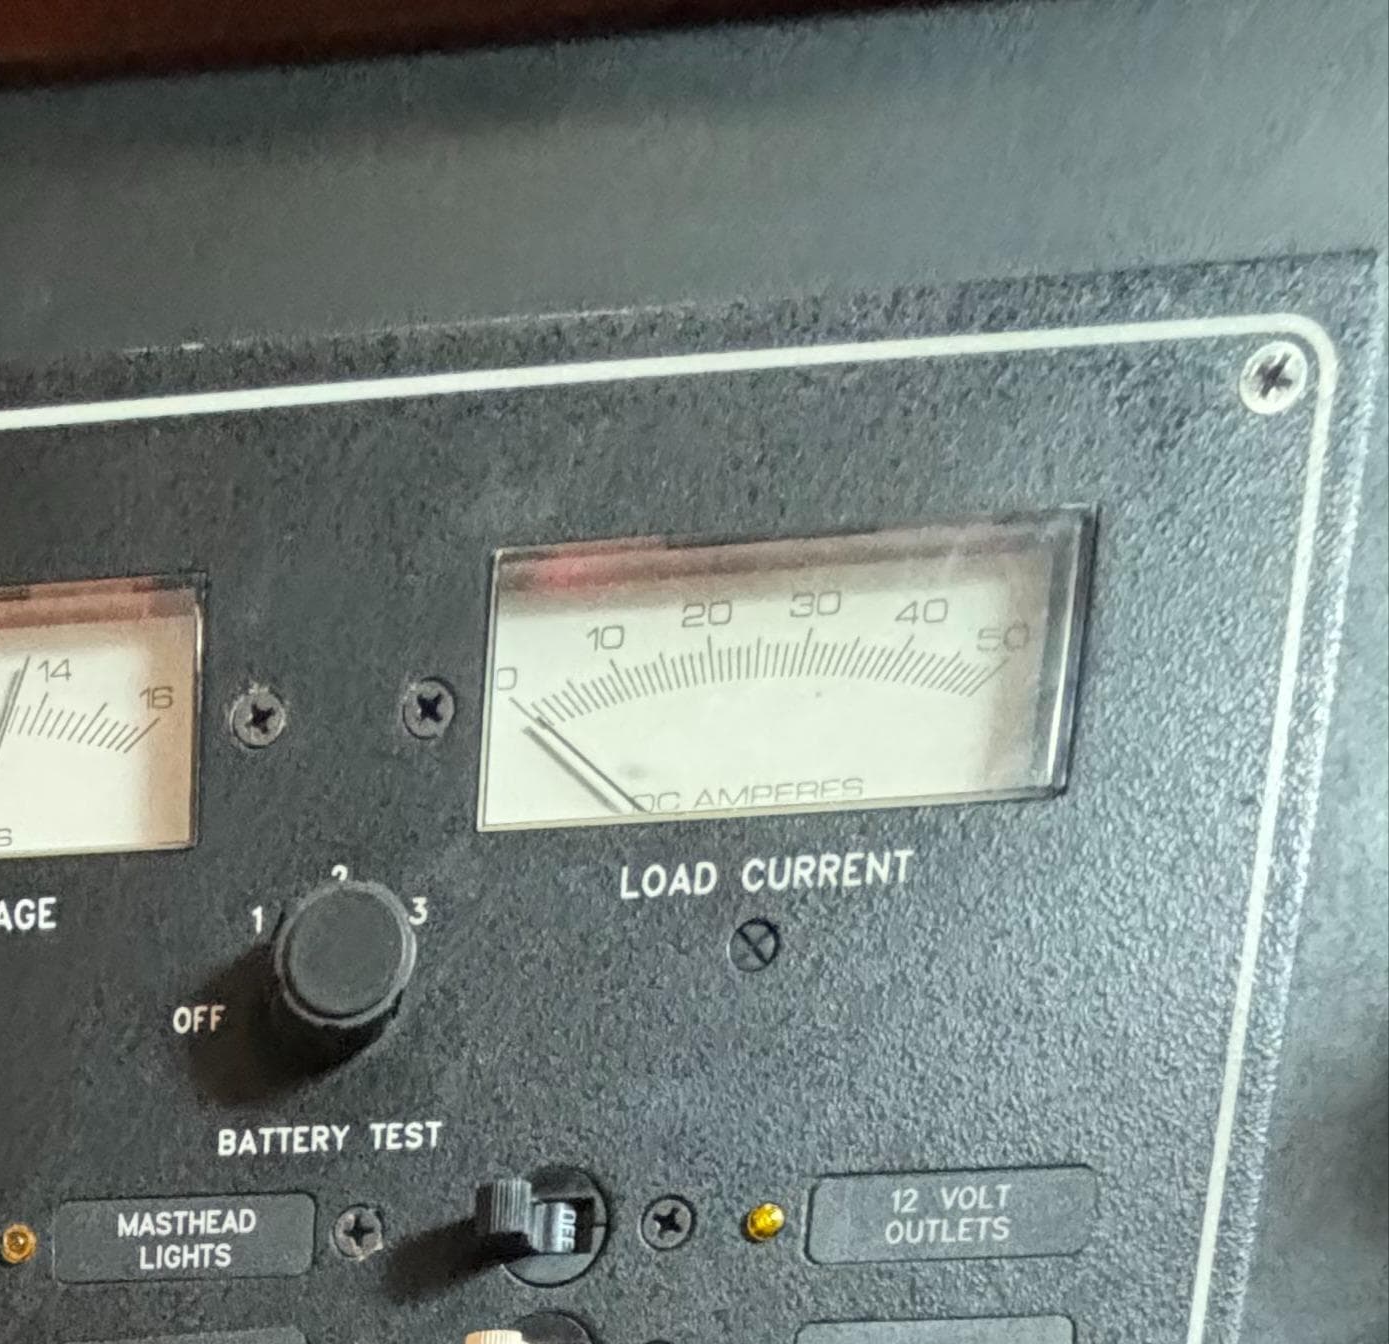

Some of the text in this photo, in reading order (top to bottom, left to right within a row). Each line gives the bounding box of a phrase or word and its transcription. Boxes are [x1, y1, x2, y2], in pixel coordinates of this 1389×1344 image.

[681, 600, 733, 628] 20
[789, 591, 842, 618] 30
[894, 598, 949, 624] 40
[586, 625, 625, 650] 10
[976, 622, 1030, 652] 50
[36, 658, 72, 682] 14
[139, 686, 173, 709] 16
[694, 777, 864, 808] AMPERES
[621, 849, 914, 899] LOAD CURRENT
[251, 905, 263, 934] 1
[409, 897, 428, 926] 3
[172, 1005, 224, 1034] OFF
[217, 1120, 443, 1156] BATTERY TEST
[891, 1183, 1012, 1213] 12 VOLT
[117, 1208, 257, 1237] MASTHEAD
[884, 1215, 1011, 1245] OUTLETS
[139, 1242, 232, 1270] LIGHTS
